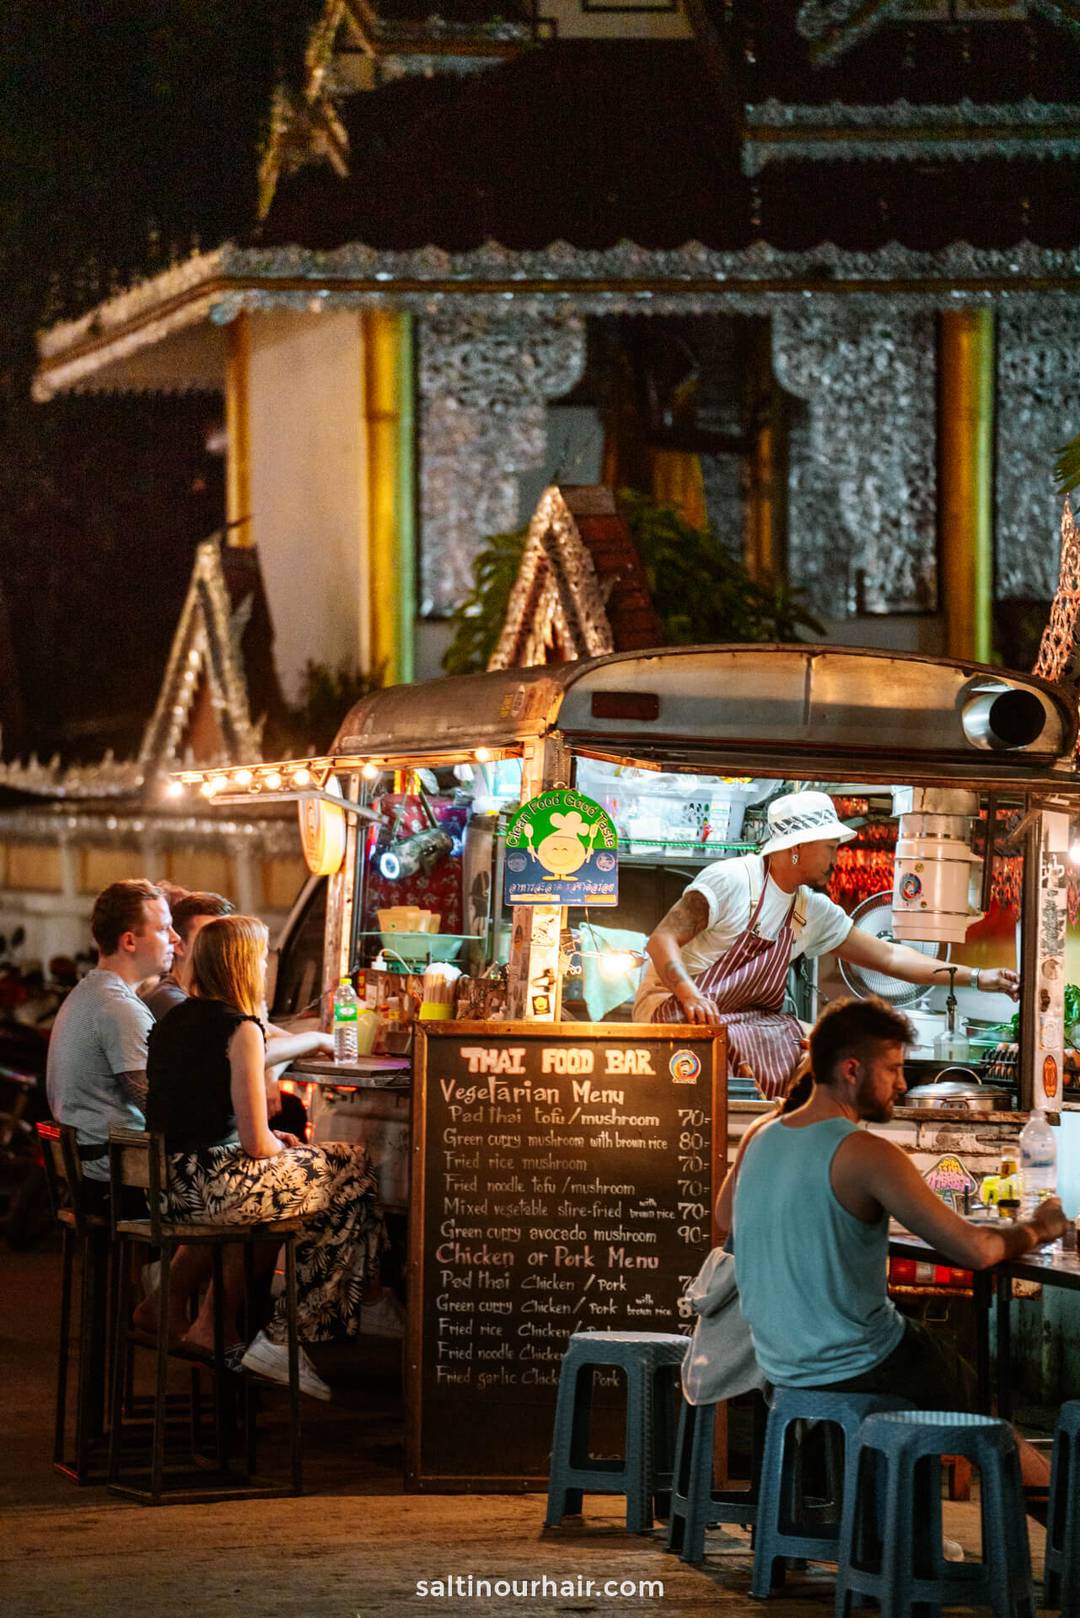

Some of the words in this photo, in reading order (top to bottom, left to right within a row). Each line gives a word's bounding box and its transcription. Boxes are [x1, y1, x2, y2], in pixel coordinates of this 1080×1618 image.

[506, 812, 531, 847] Clean
[528, 794, 560, 814] Food
[564, 793, 598, 817] Good
[596, 811, 615, 847] Taste
[460, 1047, 526, 1074] THAI
[541, 1048, 594, 1075] FOOD
[605, 1049, 656, 1075] BAR
[440, 1076, 559, 1104] Vegetarian
[572, 1080, 624, 1104] Menu
[448, 1105, 484, 1123] Pad
[443, 1128, 483, 1147] Green
[488, 1134, 521, 1149] curry
[528, 1129, 584, 1147] mushroom
[590, 1131, 612, 1148] with
[616, 1132, 646, 1148] brown
[648, 1136, 668, 1149] rice
[443, 1151, 479, 1169] Fried
[489, 1153, 514, 1169] rice
[522, 1152, 587, 1171] mushroom
[443, 1173, 477, 1192] Fried
[487, 1175, 526, 1192] noodle
[531, 1176, 557, 1193] tofu
[443, 1197, 488, 1215] Mixed
[494, 1198, 548, 1217] vegetable
[657, 1210, 675, 1219] rice
[440, 1219, 482, 1239] Green
[487, 1228, 521, 1242] curry
[529, 1223, 587, 1240] avocado
[594, 1224, 656, 1242] mushroom
[436, 1242, 515, 1266] Chicken
[528, 1252, 548, 1266] or
[554, 1245, 595, 1267] Pork
[608, 1246, 659, 1268] Menu
[440, 1270, 472, 1288] Pad
[520, 1272, 575, 1290] Chicken
[436, 1293, 474, 1312] Green
[478, 1301, 512, 1315] curry
[589, 1298, 618, 1315] Pork
[438, 1317, 473, 1336] Fried
[480, 1323, 503, 1336] rice
[437, 1341, 473, 1360] Fried
[478, 1343, 513, 1360] noodle
[436, 1365, 471, 1384] Fried
[478, 1366, 517, 1391] garlic
[593, 1370, 620, 1386] Pork
